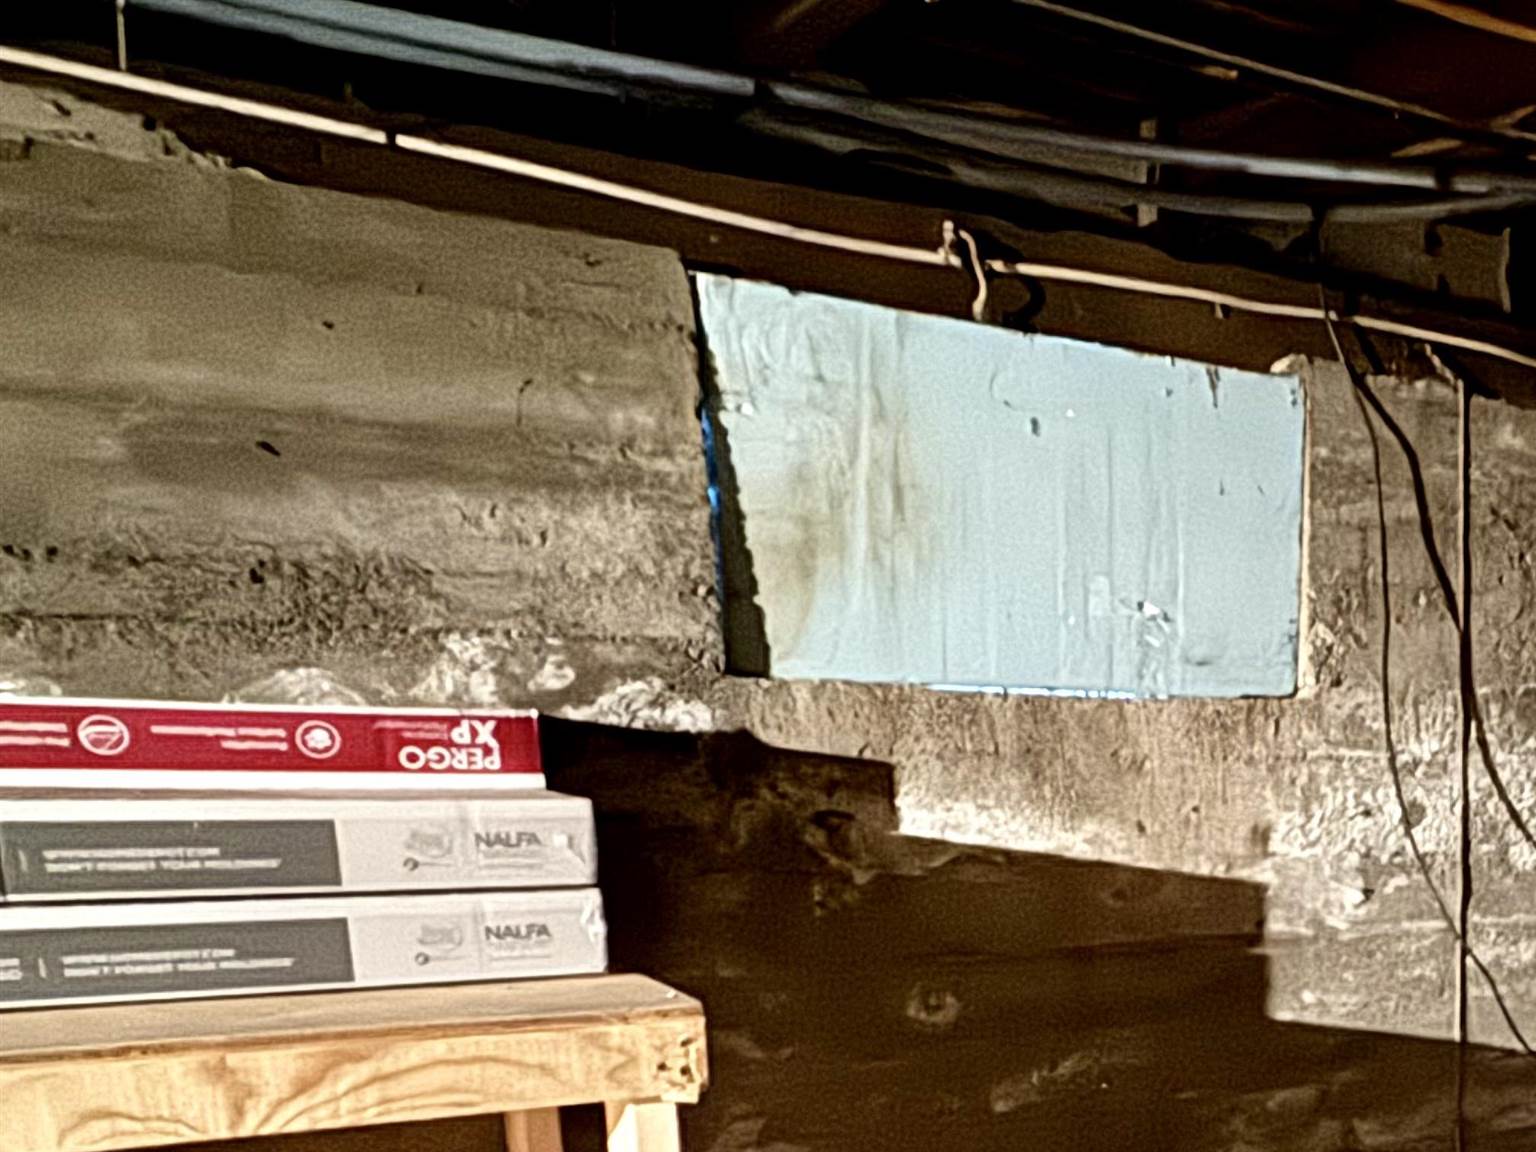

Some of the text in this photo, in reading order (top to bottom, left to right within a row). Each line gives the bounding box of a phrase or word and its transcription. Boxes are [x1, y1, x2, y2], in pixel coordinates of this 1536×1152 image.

[450, 719, 499, 745] XP
[398, 745, 501, 770] PERGO
[475, 831, 542, 848] NALFA
[485, 924, 552, 941] NALFA
